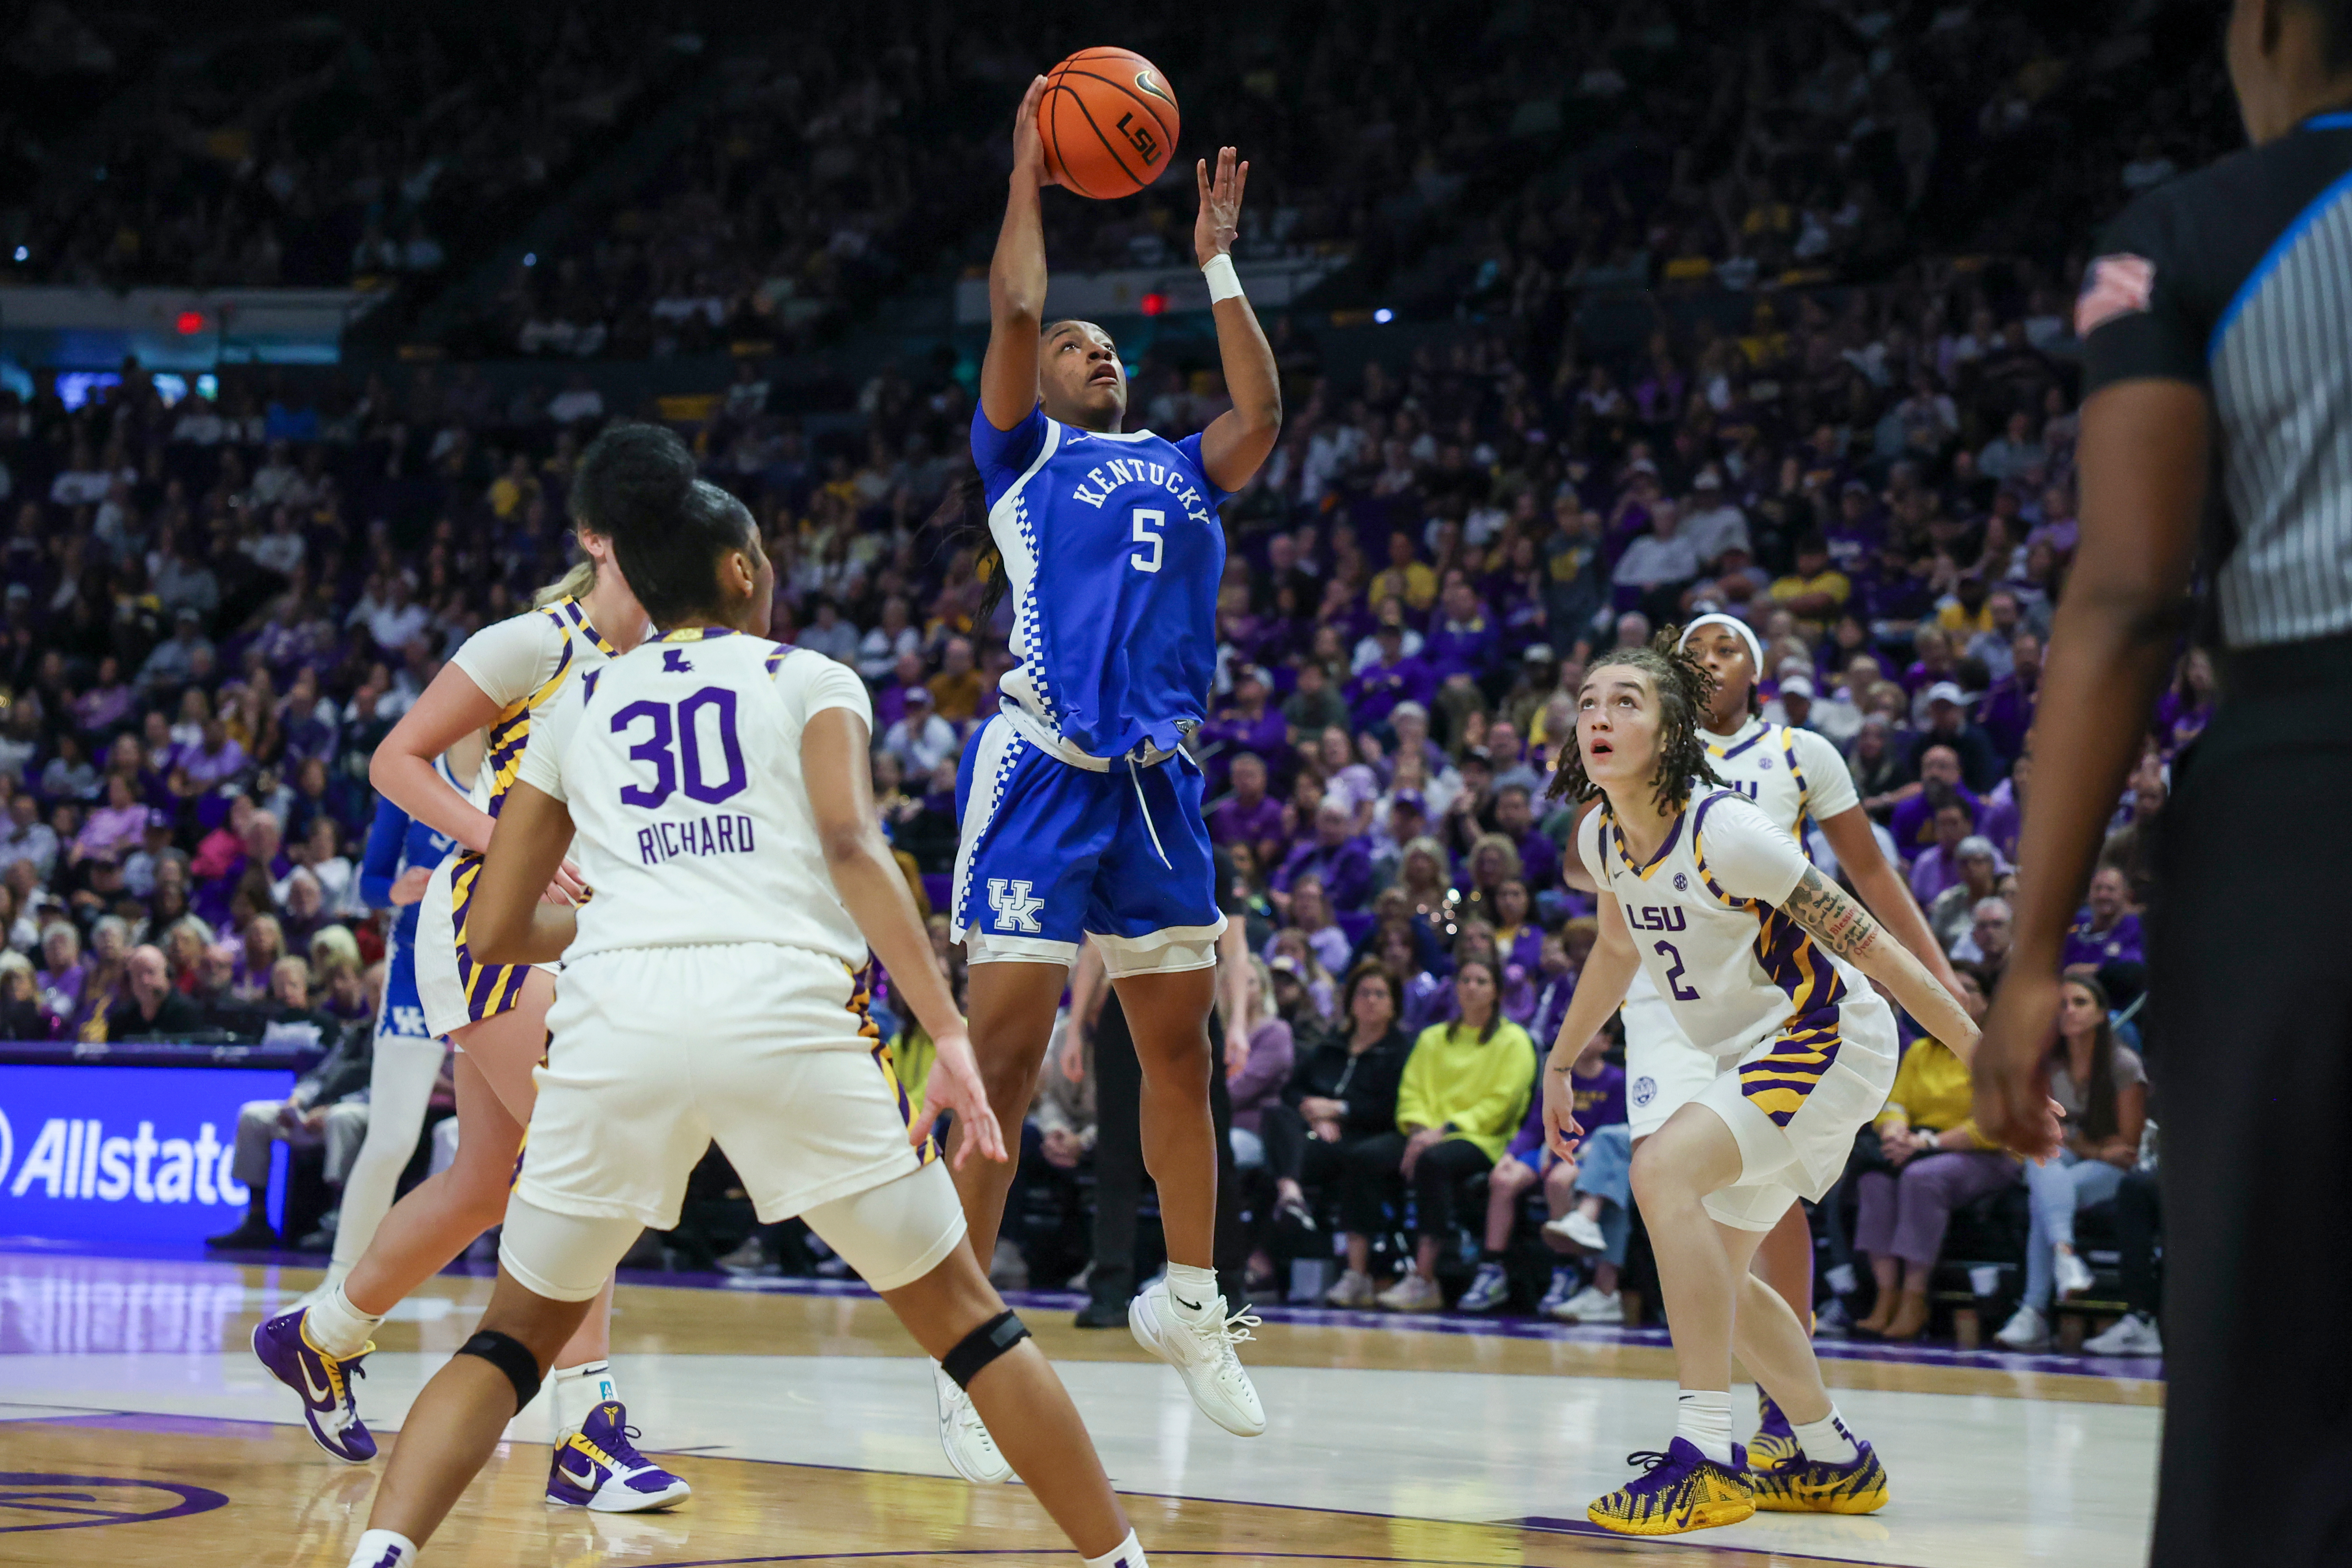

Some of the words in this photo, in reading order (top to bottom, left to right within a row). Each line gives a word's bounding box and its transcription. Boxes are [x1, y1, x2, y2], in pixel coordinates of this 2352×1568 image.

[1116, 112, 1162, 166] LSU
[1072, 459, 1210, 525] KENTUCKY
[1131, 508, 1165, 573] 5
[610, 686, 747, 810] 30
[637, 815, 755, 865] RICHARD
[986, 877, 1045, 933] UK
[1626, 903, 1686, 931] LSU
[1654, 940, 1701, 1001] 2
[392, 1006, 426, 1036] UK
